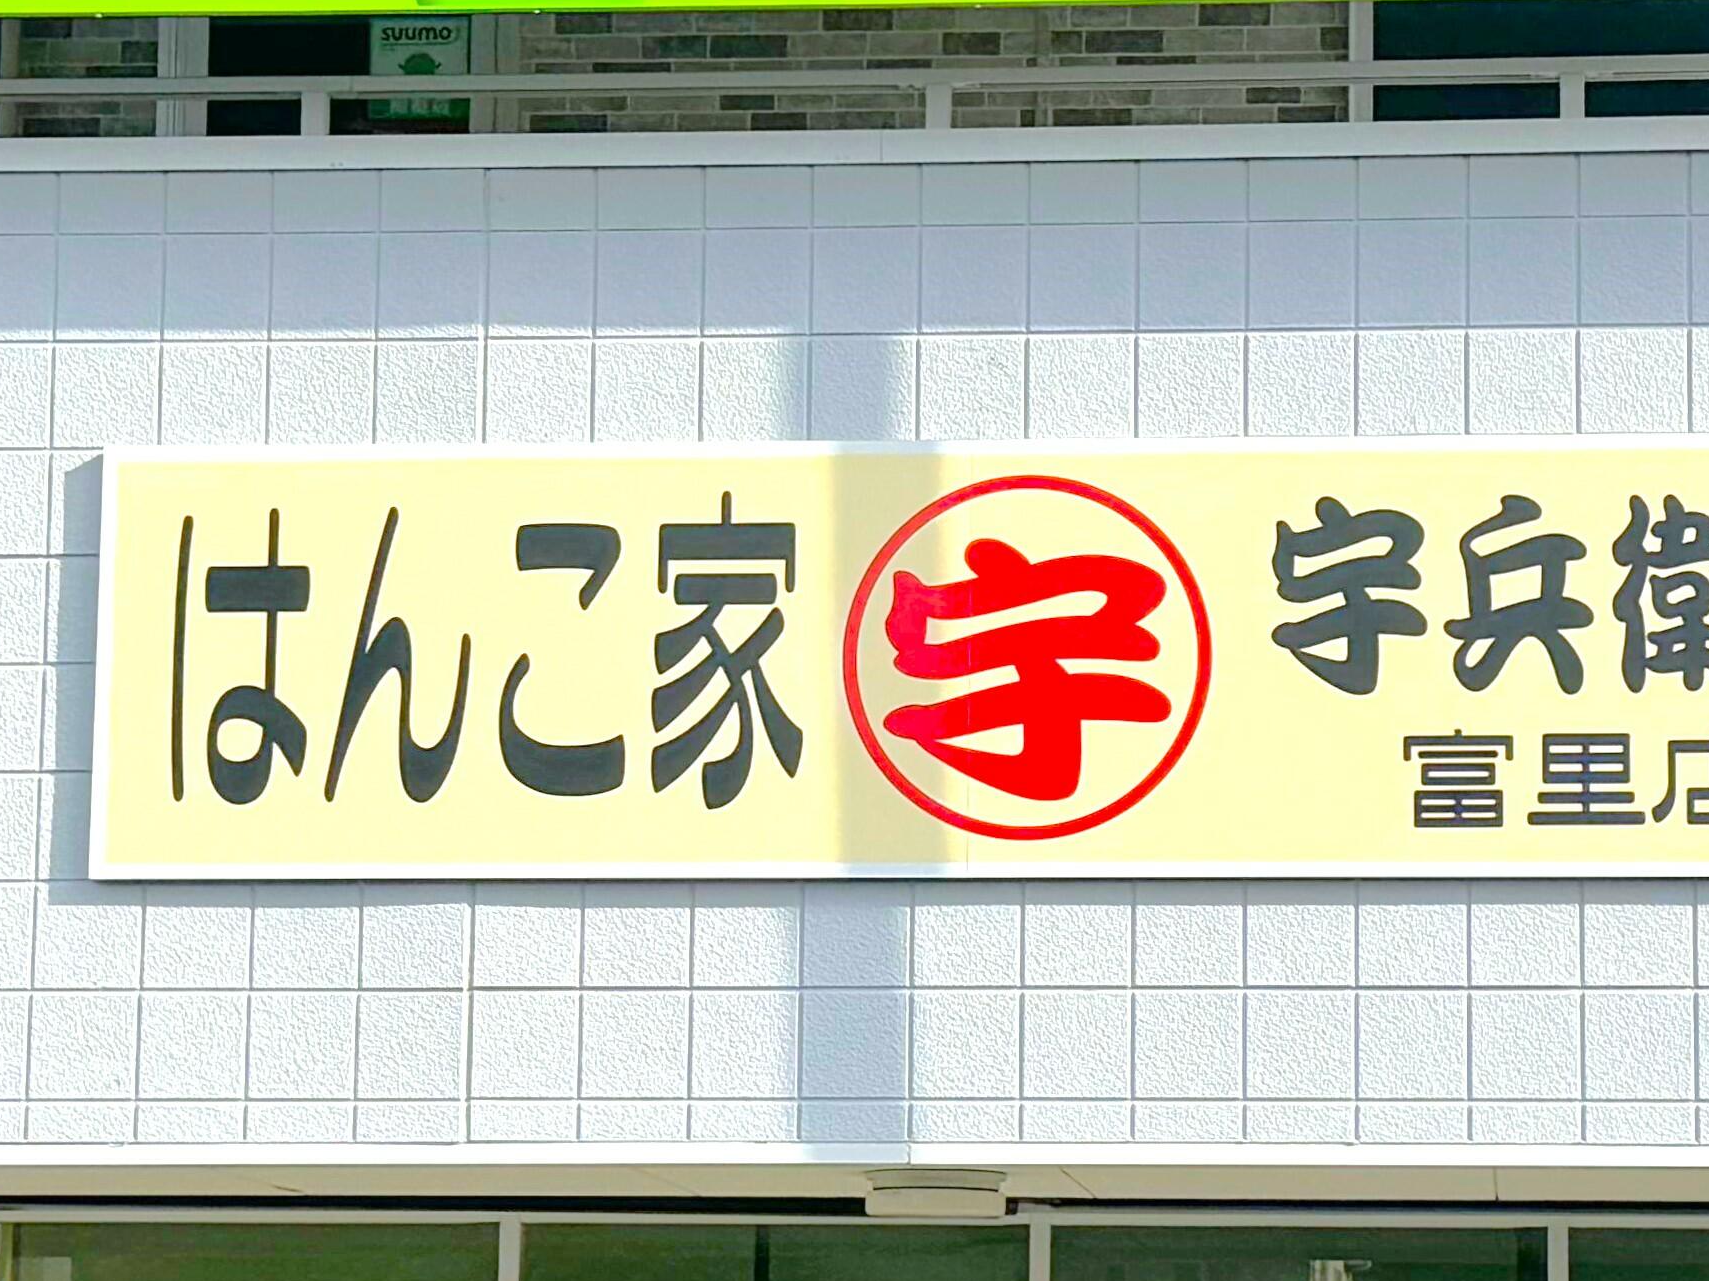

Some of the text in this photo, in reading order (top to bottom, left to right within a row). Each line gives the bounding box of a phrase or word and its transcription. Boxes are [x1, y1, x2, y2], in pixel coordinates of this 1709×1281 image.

[171, 491, 804, 811] はんこ家
[883, 537, 1172, 801] 宇
